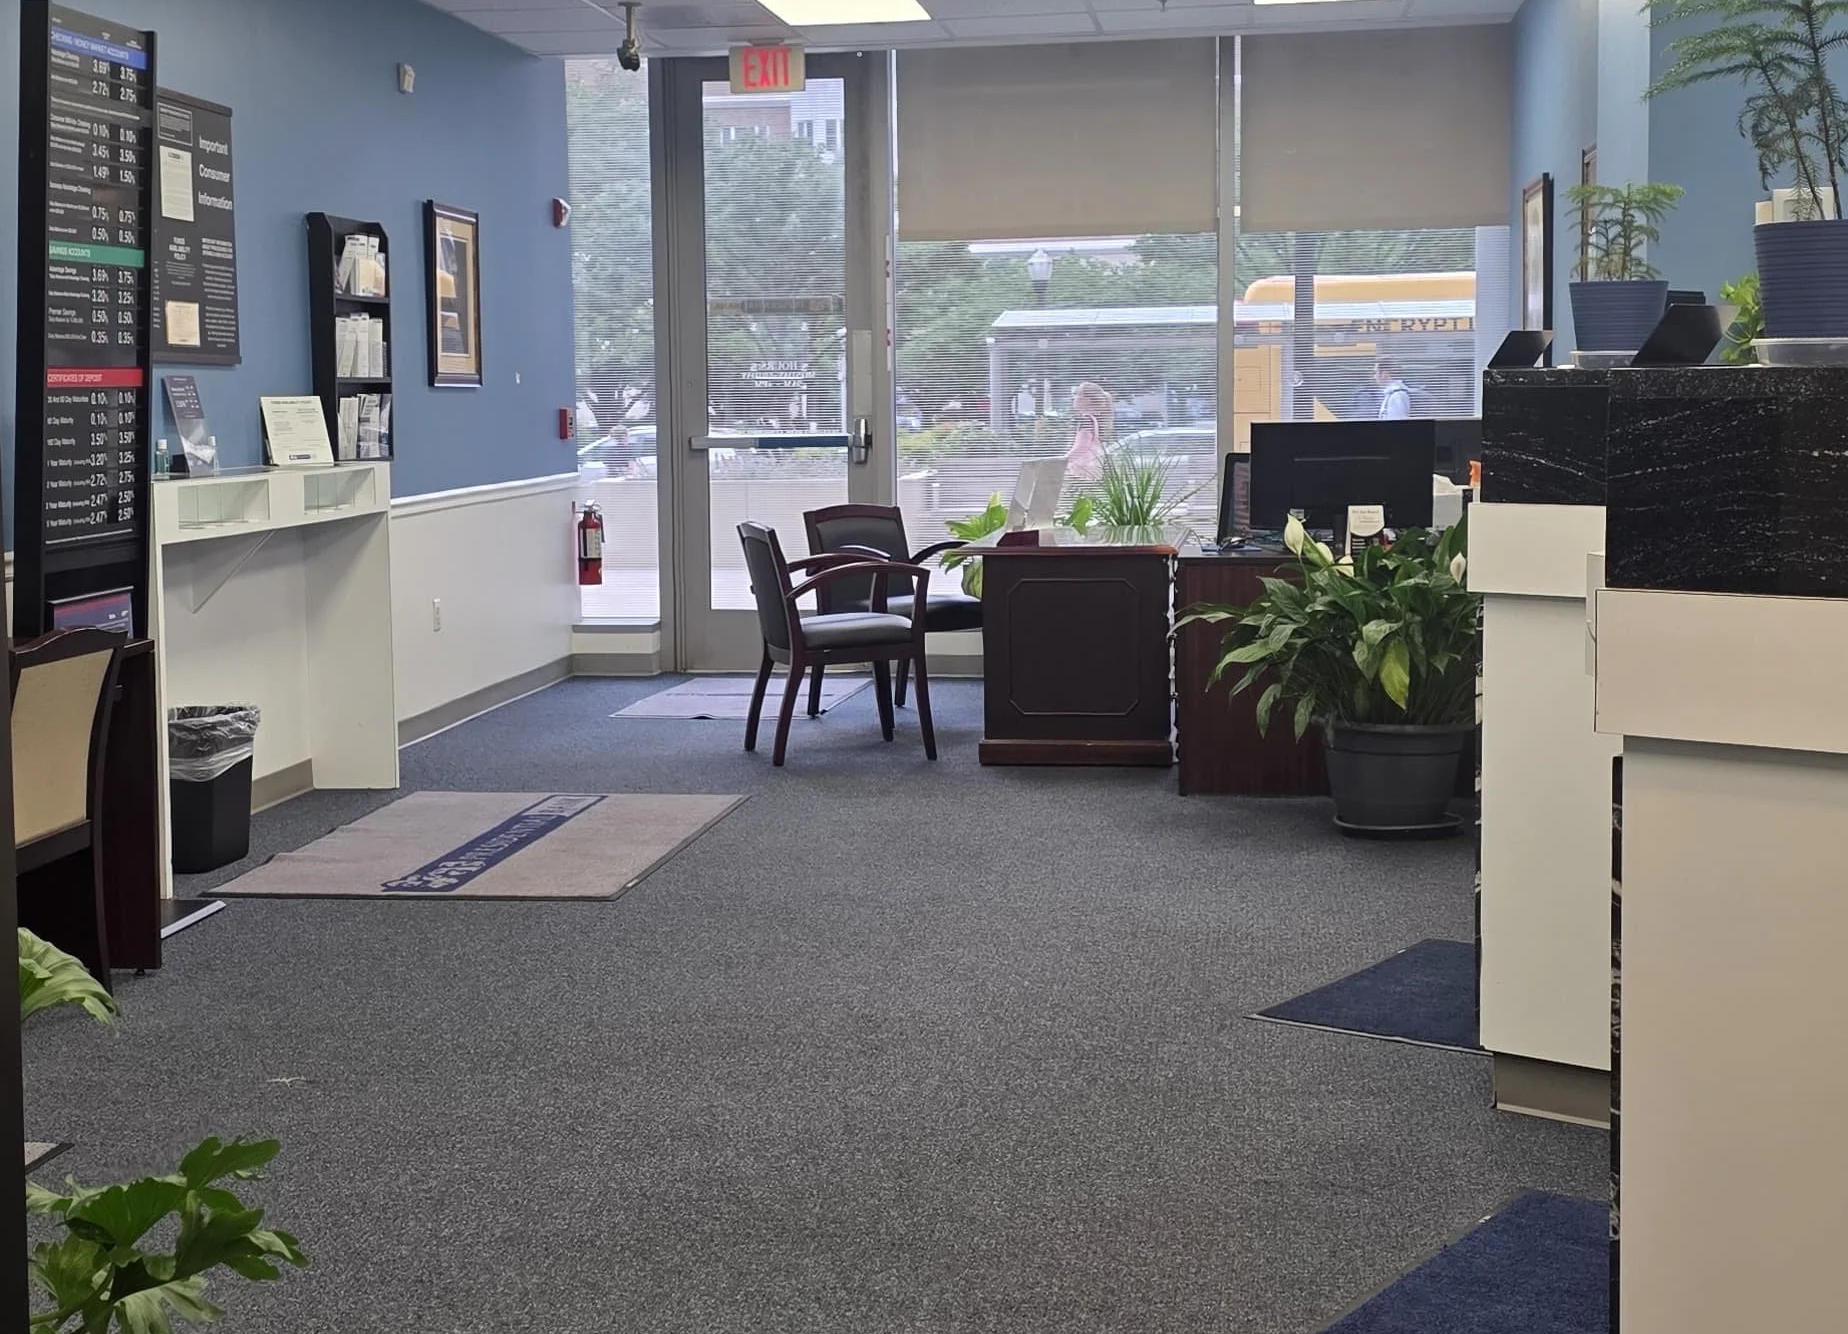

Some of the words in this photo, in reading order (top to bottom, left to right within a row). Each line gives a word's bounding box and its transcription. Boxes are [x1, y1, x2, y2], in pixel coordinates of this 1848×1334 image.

[743, 47, 789, 88] EXIT
[199, 135, 228, 155] Important
[199, 163, 231, 182] Consumer
[198, 190, 233, 211] Information
